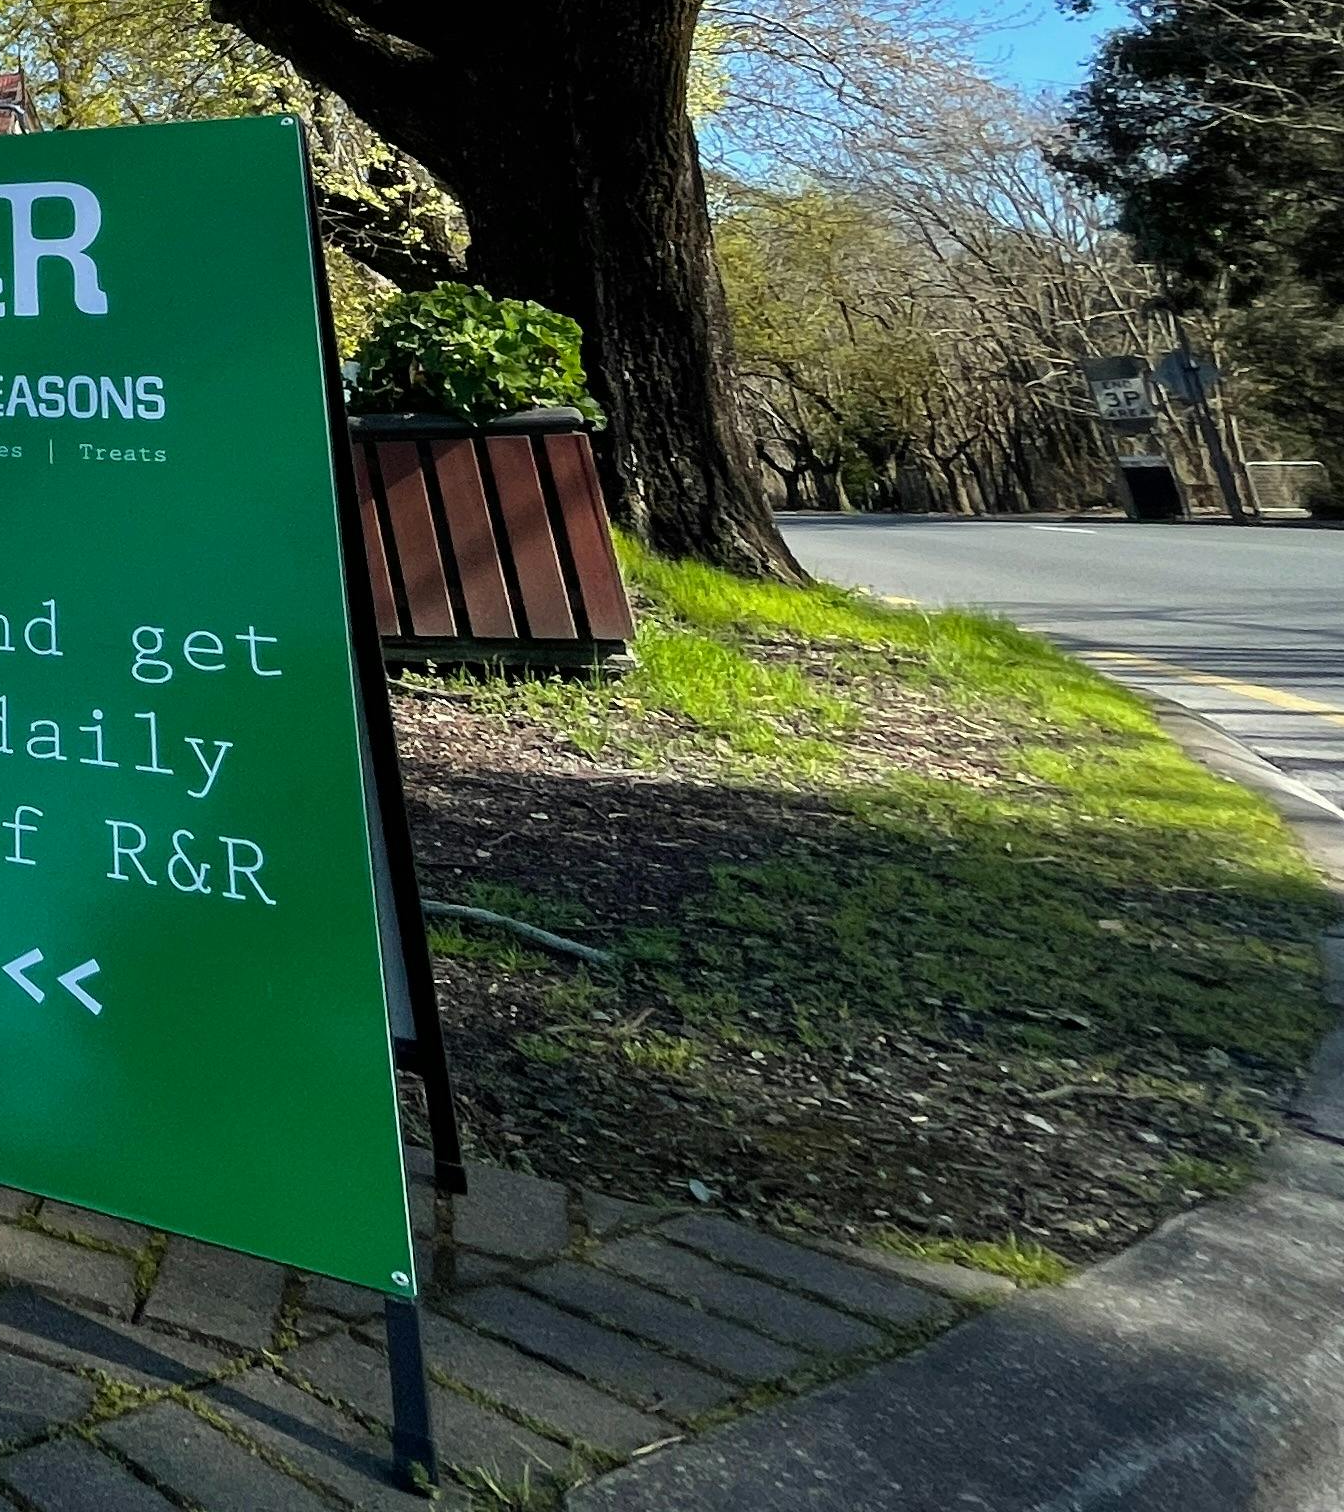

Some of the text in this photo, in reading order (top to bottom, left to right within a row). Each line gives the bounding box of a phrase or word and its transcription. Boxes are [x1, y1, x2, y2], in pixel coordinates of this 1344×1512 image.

[1104, 390, 1141, 407] 3P
[79, 443, 168, 464] Treats
[130, 625, 283, 684] get
[105, 819, 278, 906] R&R
